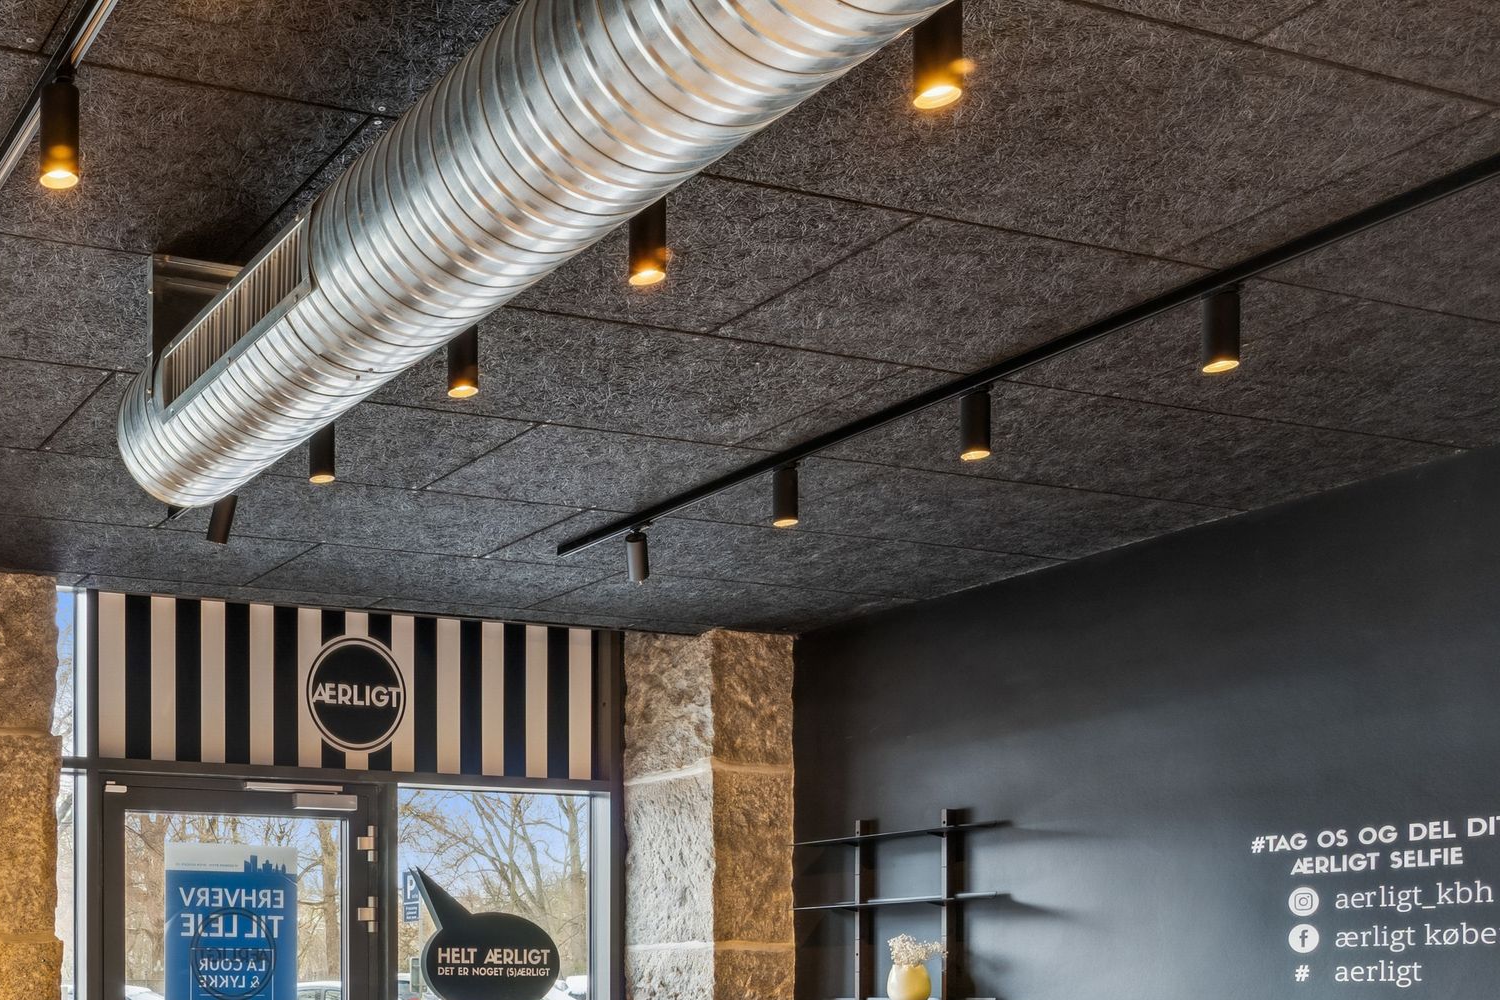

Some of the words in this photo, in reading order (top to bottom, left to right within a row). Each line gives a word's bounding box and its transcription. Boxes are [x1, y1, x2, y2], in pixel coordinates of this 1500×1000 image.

[1251, 833, 1308, 853] #TAG
[1317, 829, 1349, 848] OS
[1358, 825, 1398, 845] OG
[1409, 820, 1457, 841] DEL
[1290, 852, 1381, 876] ÆRLIGT
[1390, 847, 1464, 869] SELFIE
[1335, 880, 1494, 913] aerligt_kbh
[1335, 925, 1416, 952] ærligt
[1425, 922, 1500, 946] købe
[438, 947, 477, 964] HELT
[483, 948, 551, 965] ÆRLIGT
[437, 966, 455, 976] DET
[457, 967, 469, 976] ER
[472, 967, 504, 977] NOGET
[1334, 960, 1422, 987] aerligt
